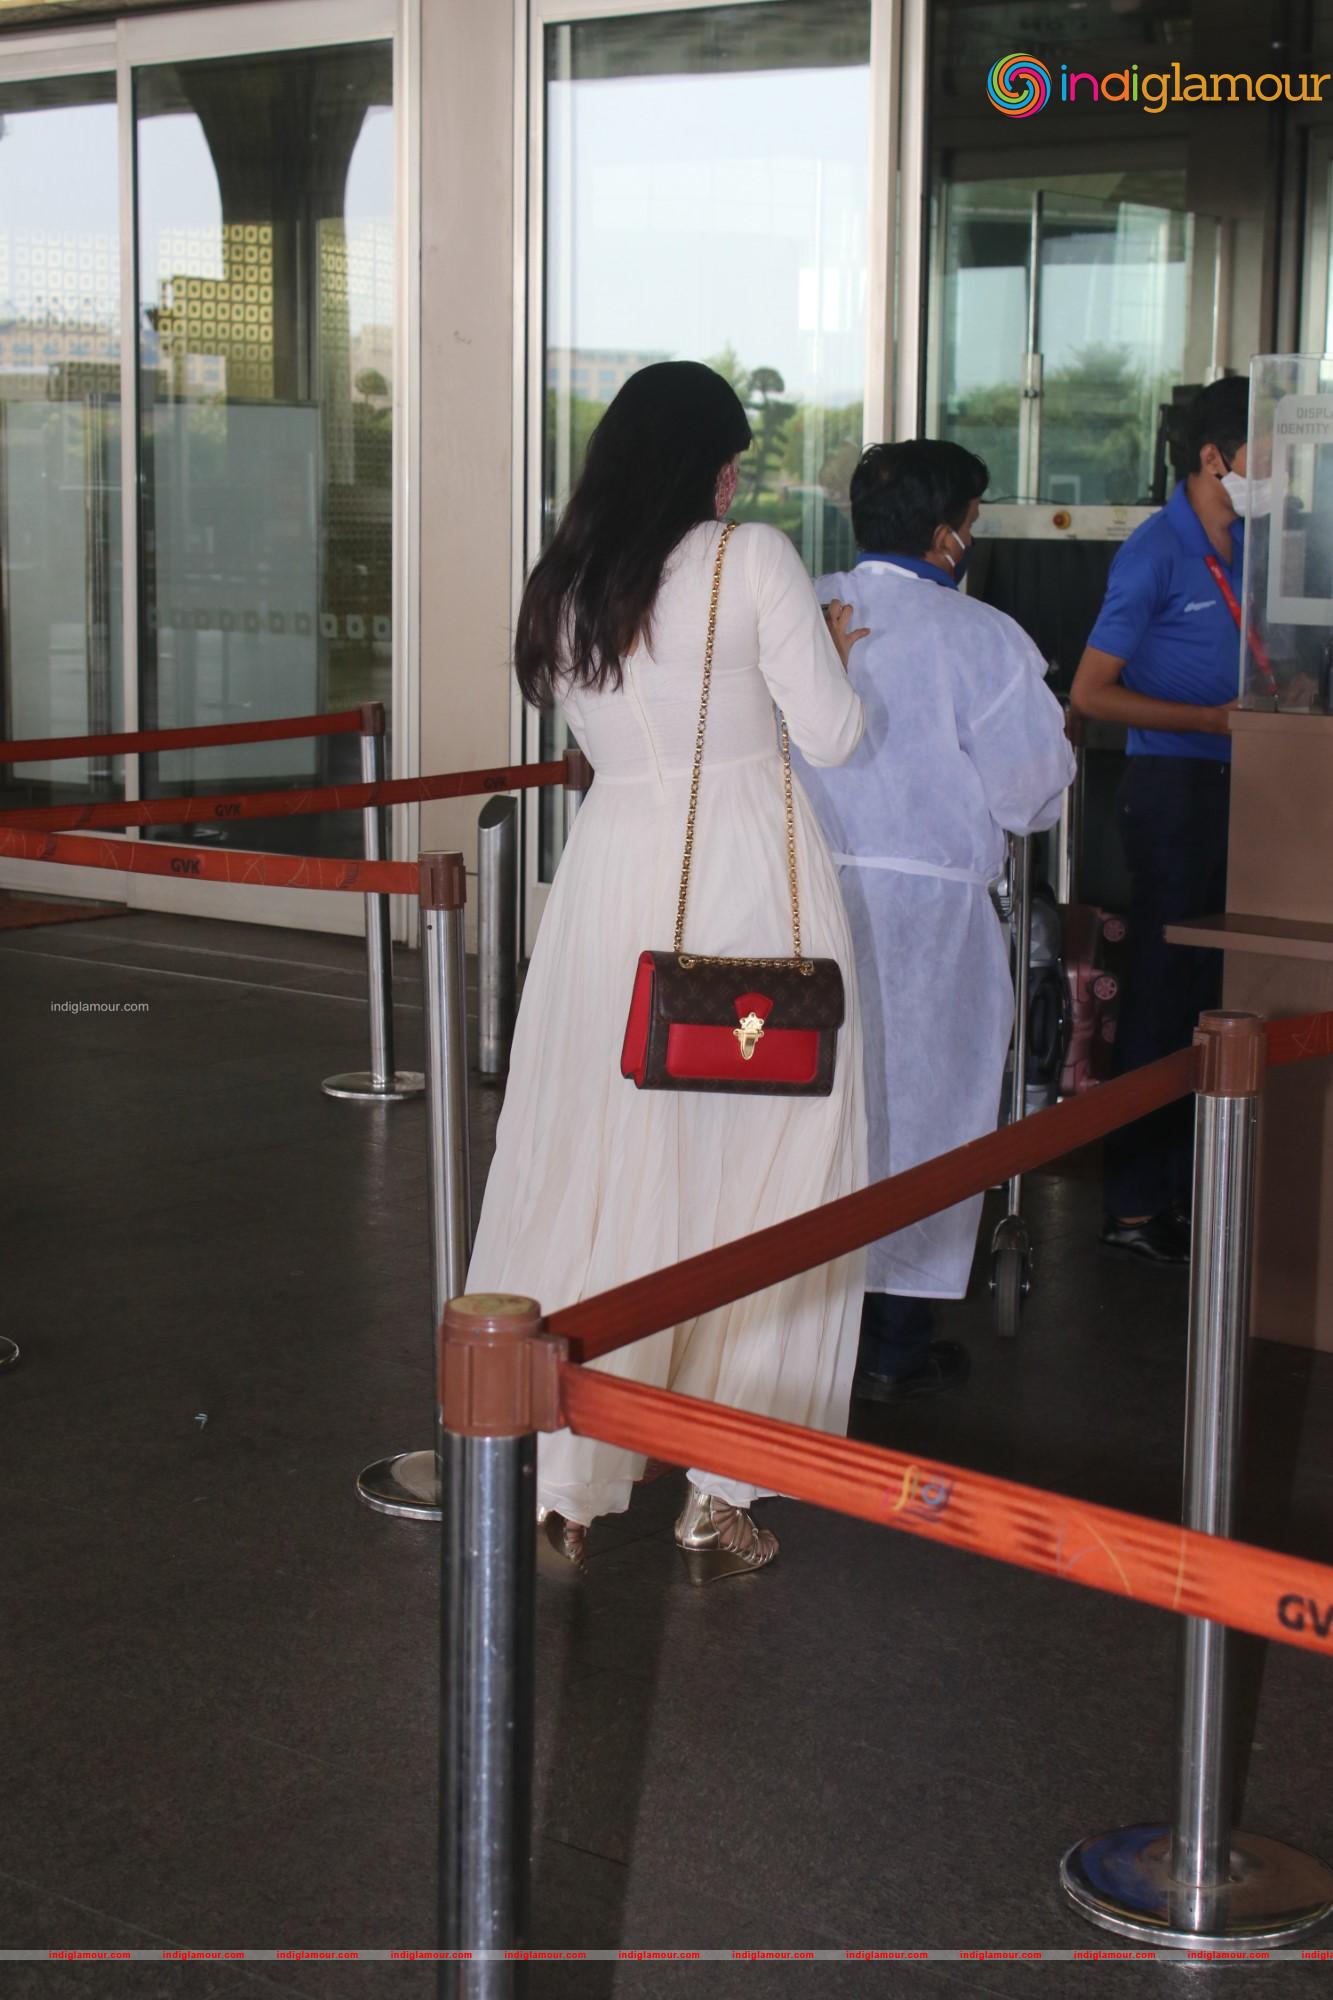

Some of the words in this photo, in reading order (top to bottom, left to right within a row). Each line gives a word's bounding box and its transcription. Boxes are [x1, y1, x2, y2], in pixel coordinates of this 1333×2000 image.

[1276, 423, 1329, 435] IDENTITY
[215, 803, 241, 817] GVK
[171, 857, 201, 874] GVK
